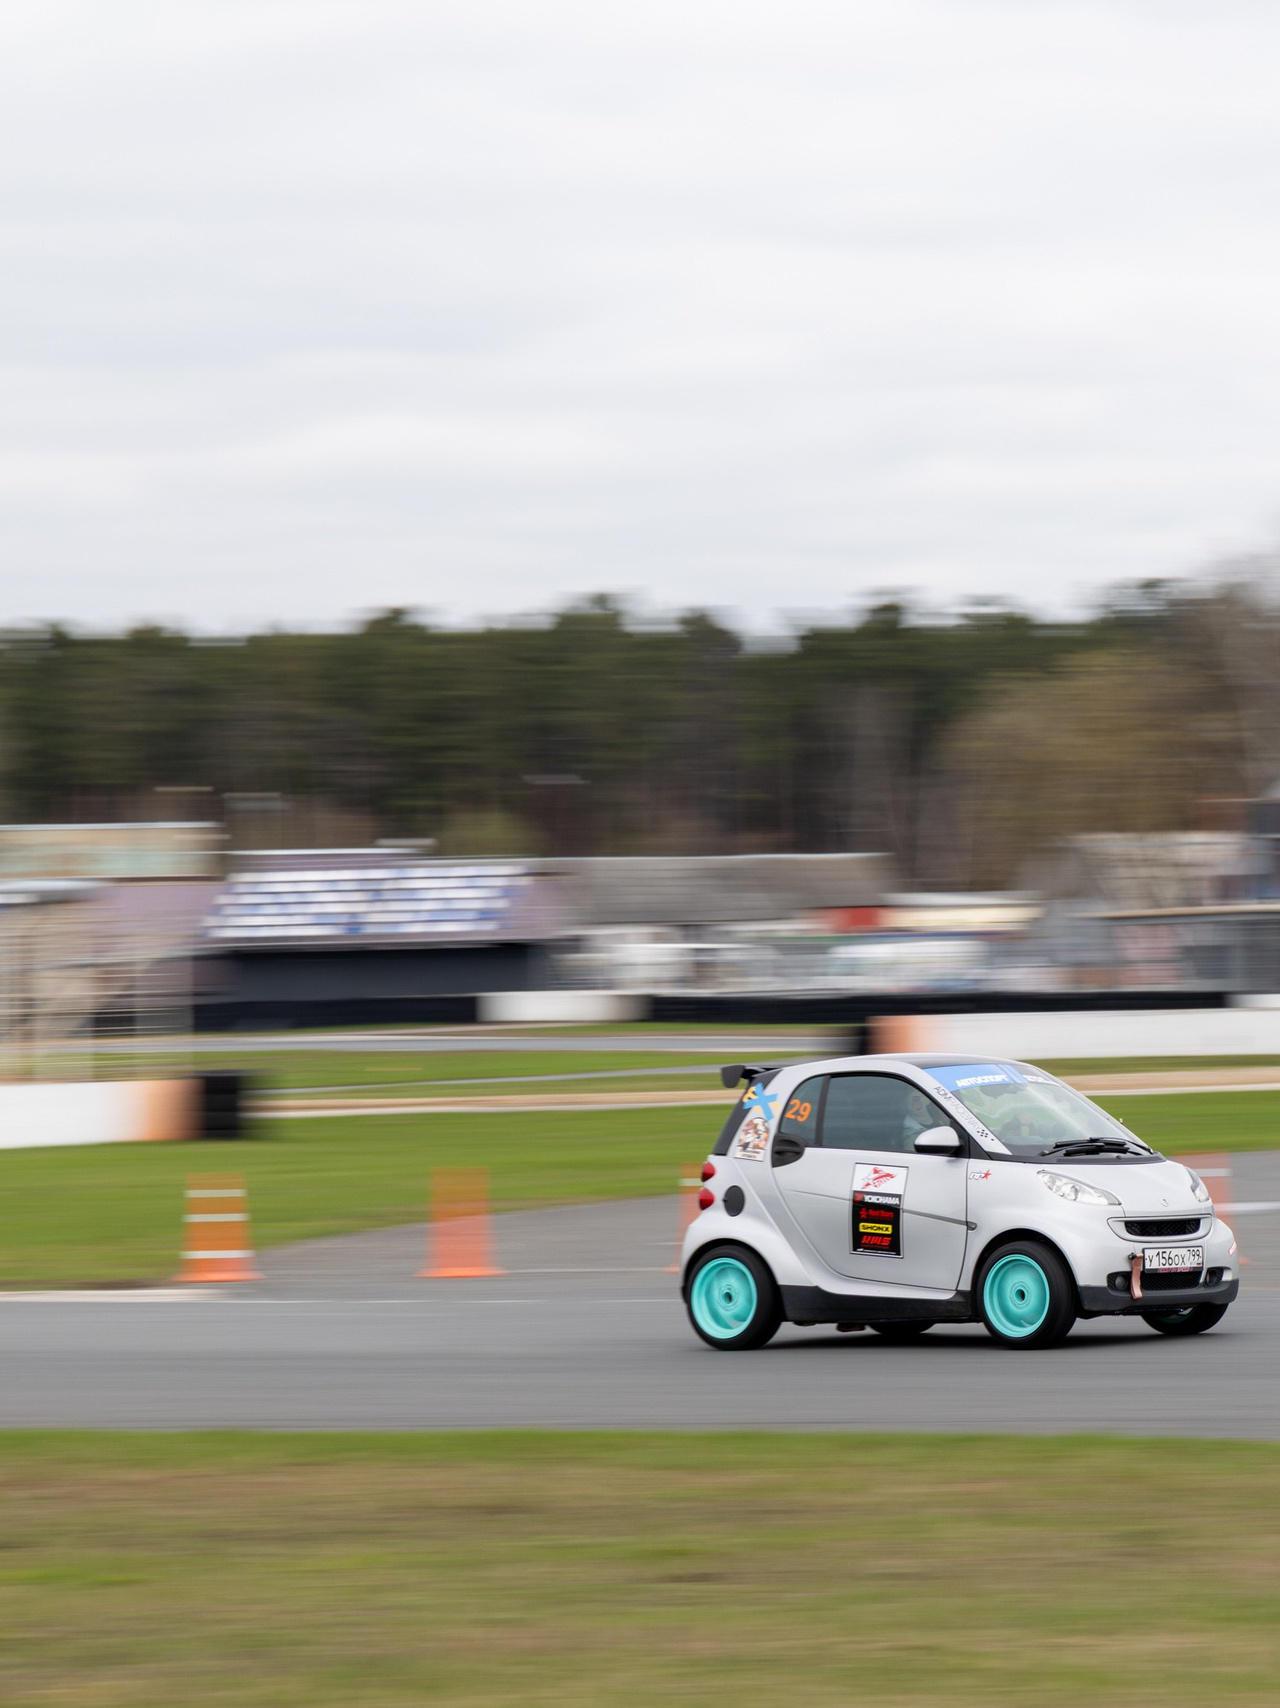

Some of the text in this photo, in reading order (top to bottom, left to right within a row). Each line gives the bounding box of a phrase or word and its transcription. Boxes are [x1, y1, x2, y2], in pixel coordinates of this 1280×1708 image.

[785, 1099, 811, 1122] 29
[864, 1195, 899, 1204] YOKOHAMA
[1187, 1250, 1200, 1261] 799
